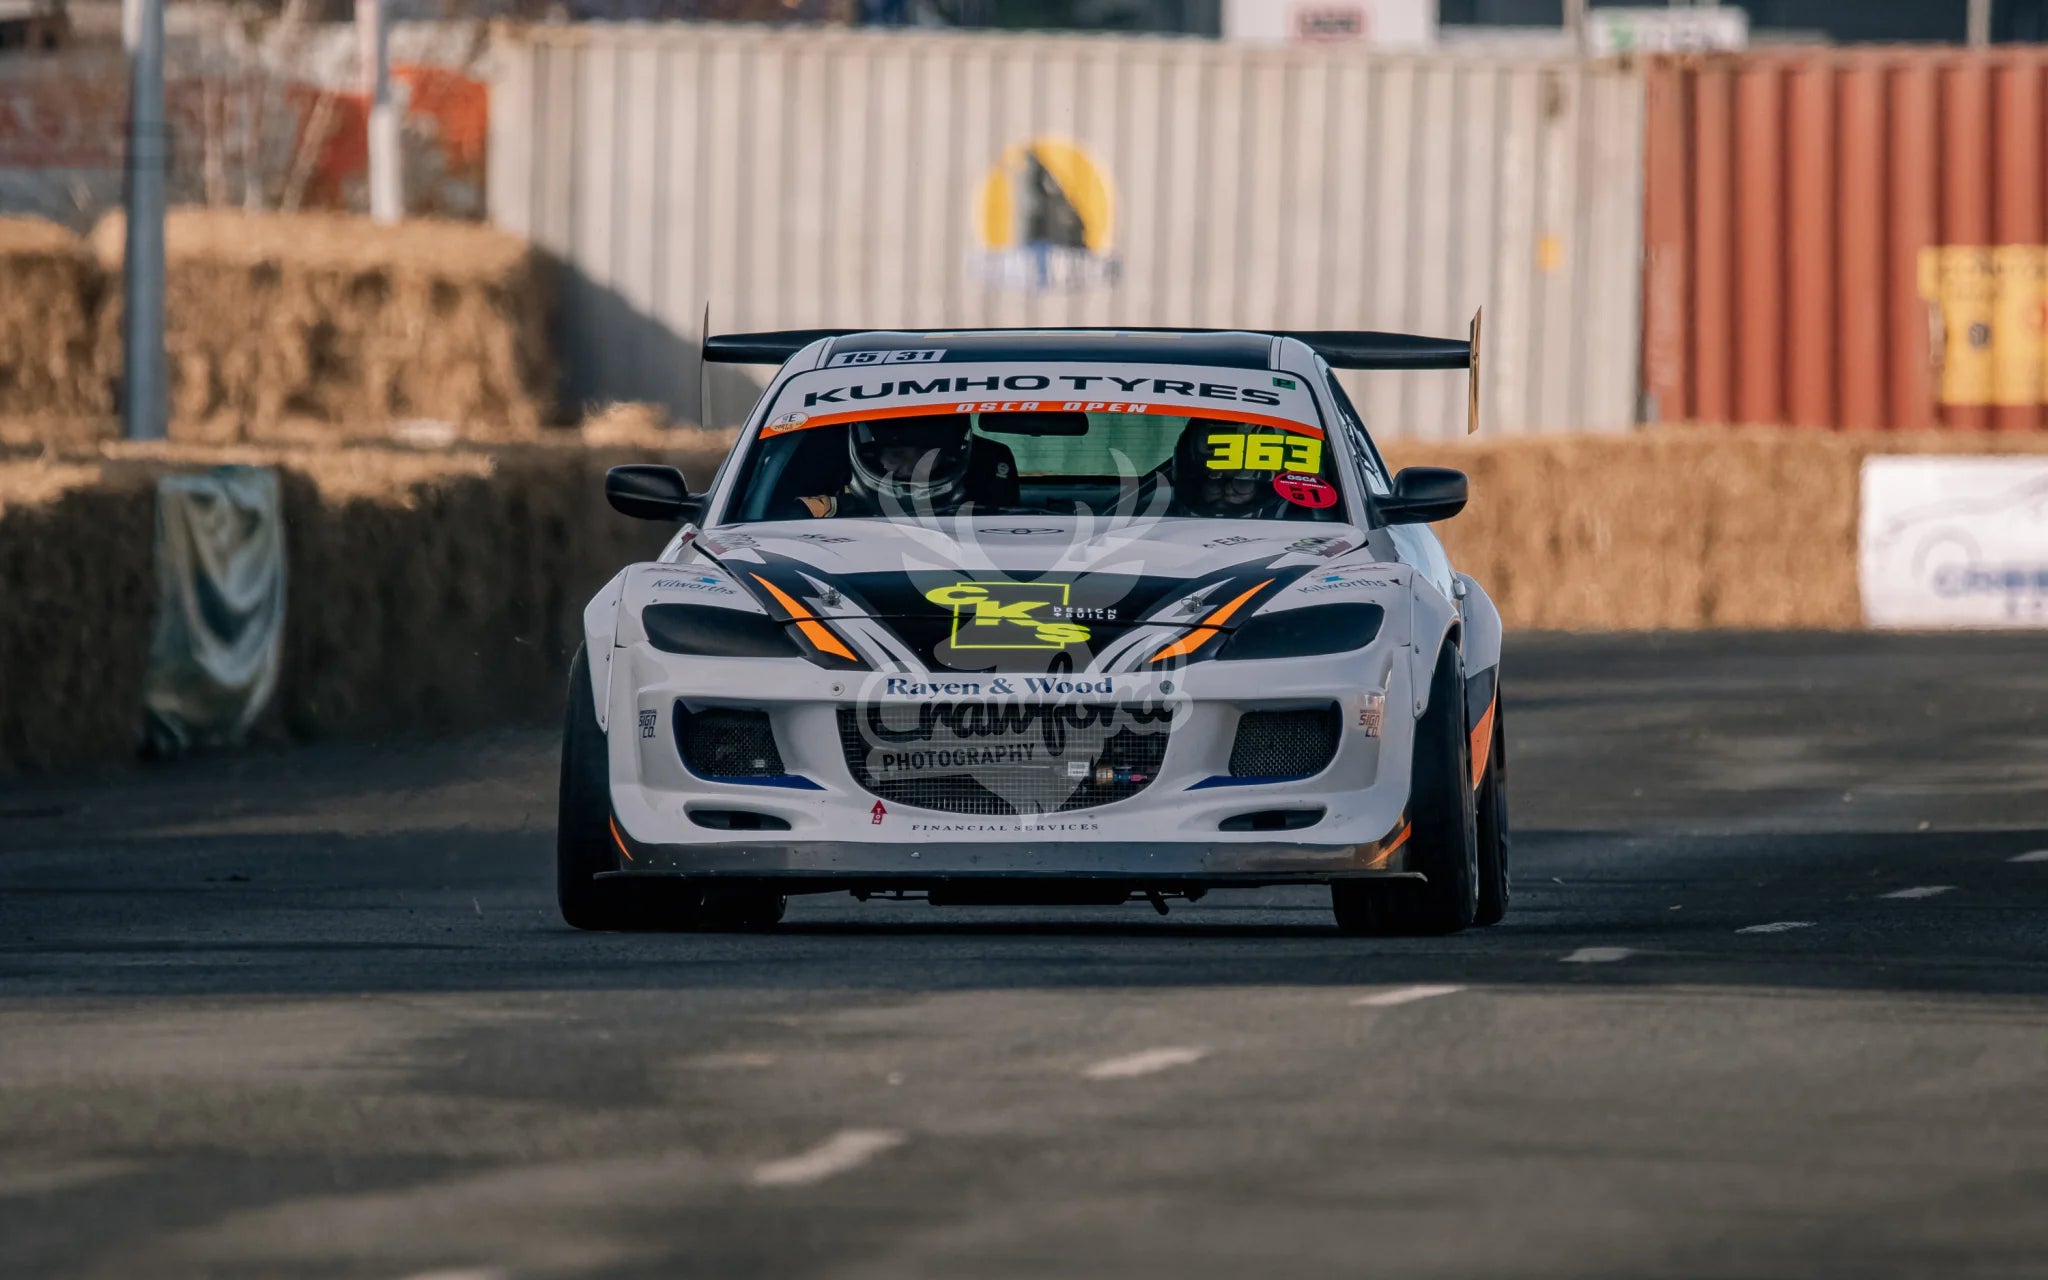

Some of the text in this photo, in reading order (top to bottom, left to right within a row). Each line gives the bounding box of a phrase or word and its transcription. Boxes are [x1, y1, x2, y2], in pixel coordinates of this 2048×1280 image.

[843, 351, 936, 364] 15 31
[804, 375, 1280, 408] KUMHO TYRES
[956, 402, 1147, 413] OSCA OPEN
[1206, 434, 1322, 474] 363
[1287, 474, 1318, 483] OSCA
[652, 579, 736, 595] Kilworths
[1297, 578, 1387, 594] Kilworths
[925, 586, 1091, 643] CKS
[989, 678, 1015, 694] &
[1023, 677, 1113, 694] Wood
[1014, 823, 1099, 832] SERVICES
